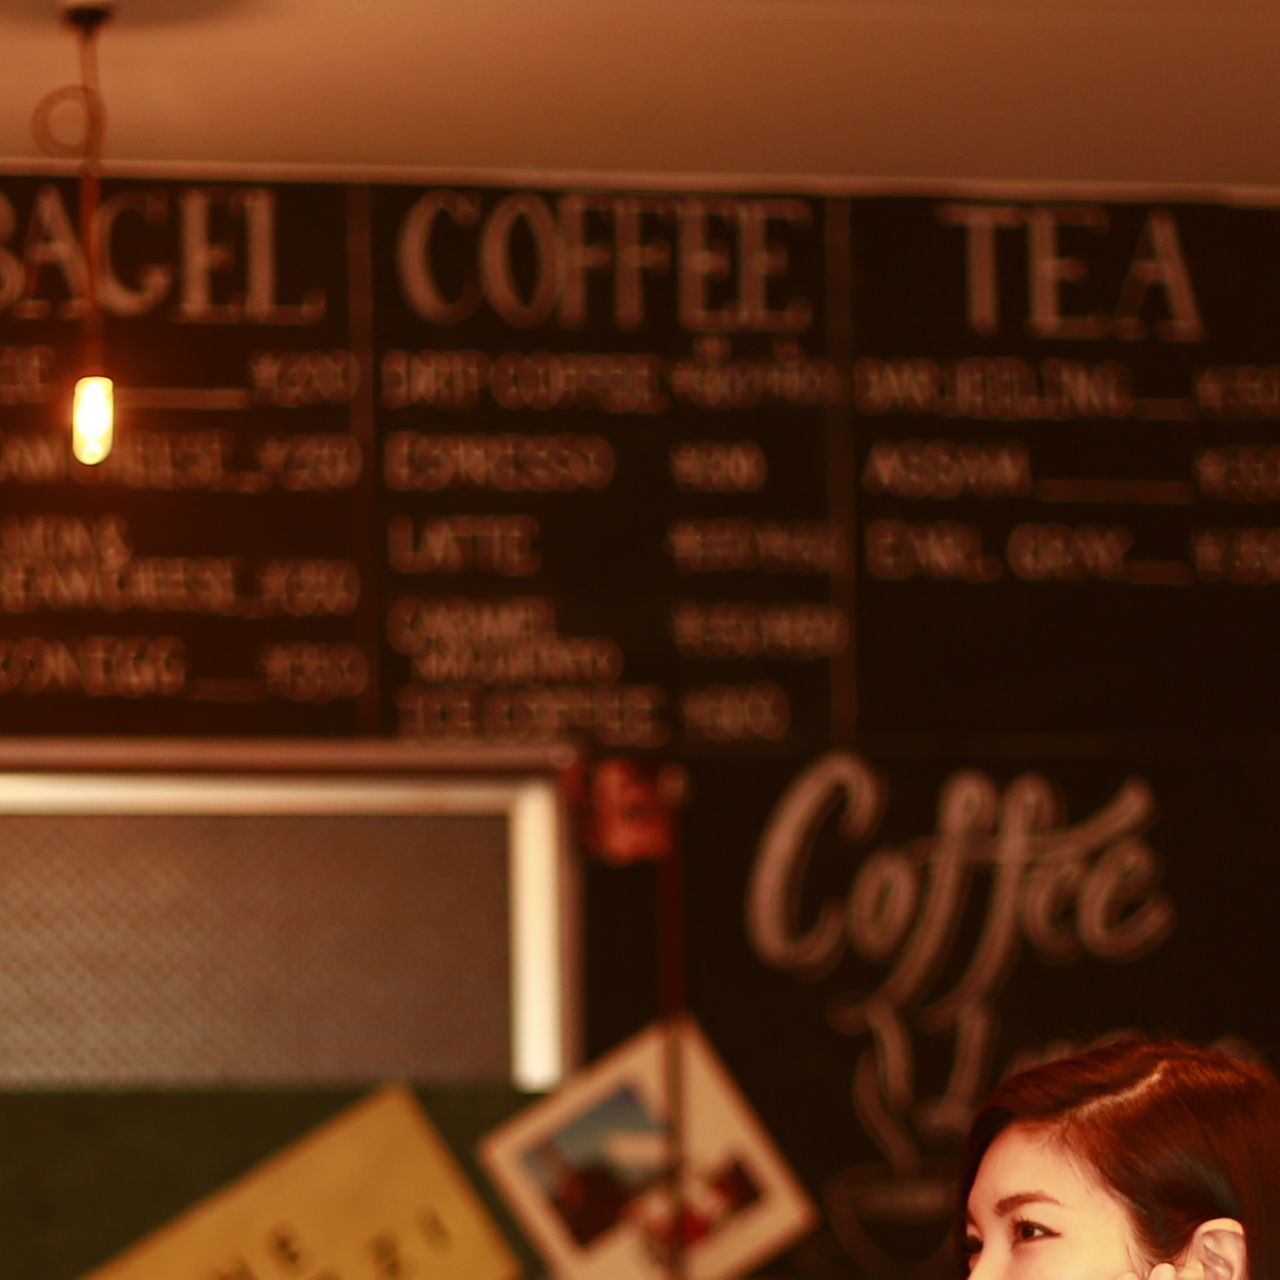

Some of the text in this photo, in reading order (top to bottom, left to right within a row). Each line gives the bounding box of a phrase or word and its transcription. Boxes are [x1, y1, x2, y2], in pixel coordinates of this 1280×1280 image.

[399, 190, 811, 330] COFFEE
[935, 206, 1208, 341] TEA
[491, 353, 667, 412] COFFEE
[389, 516, 538, 573] LATTE
[747, 750, 1173, 1030] Coffee
